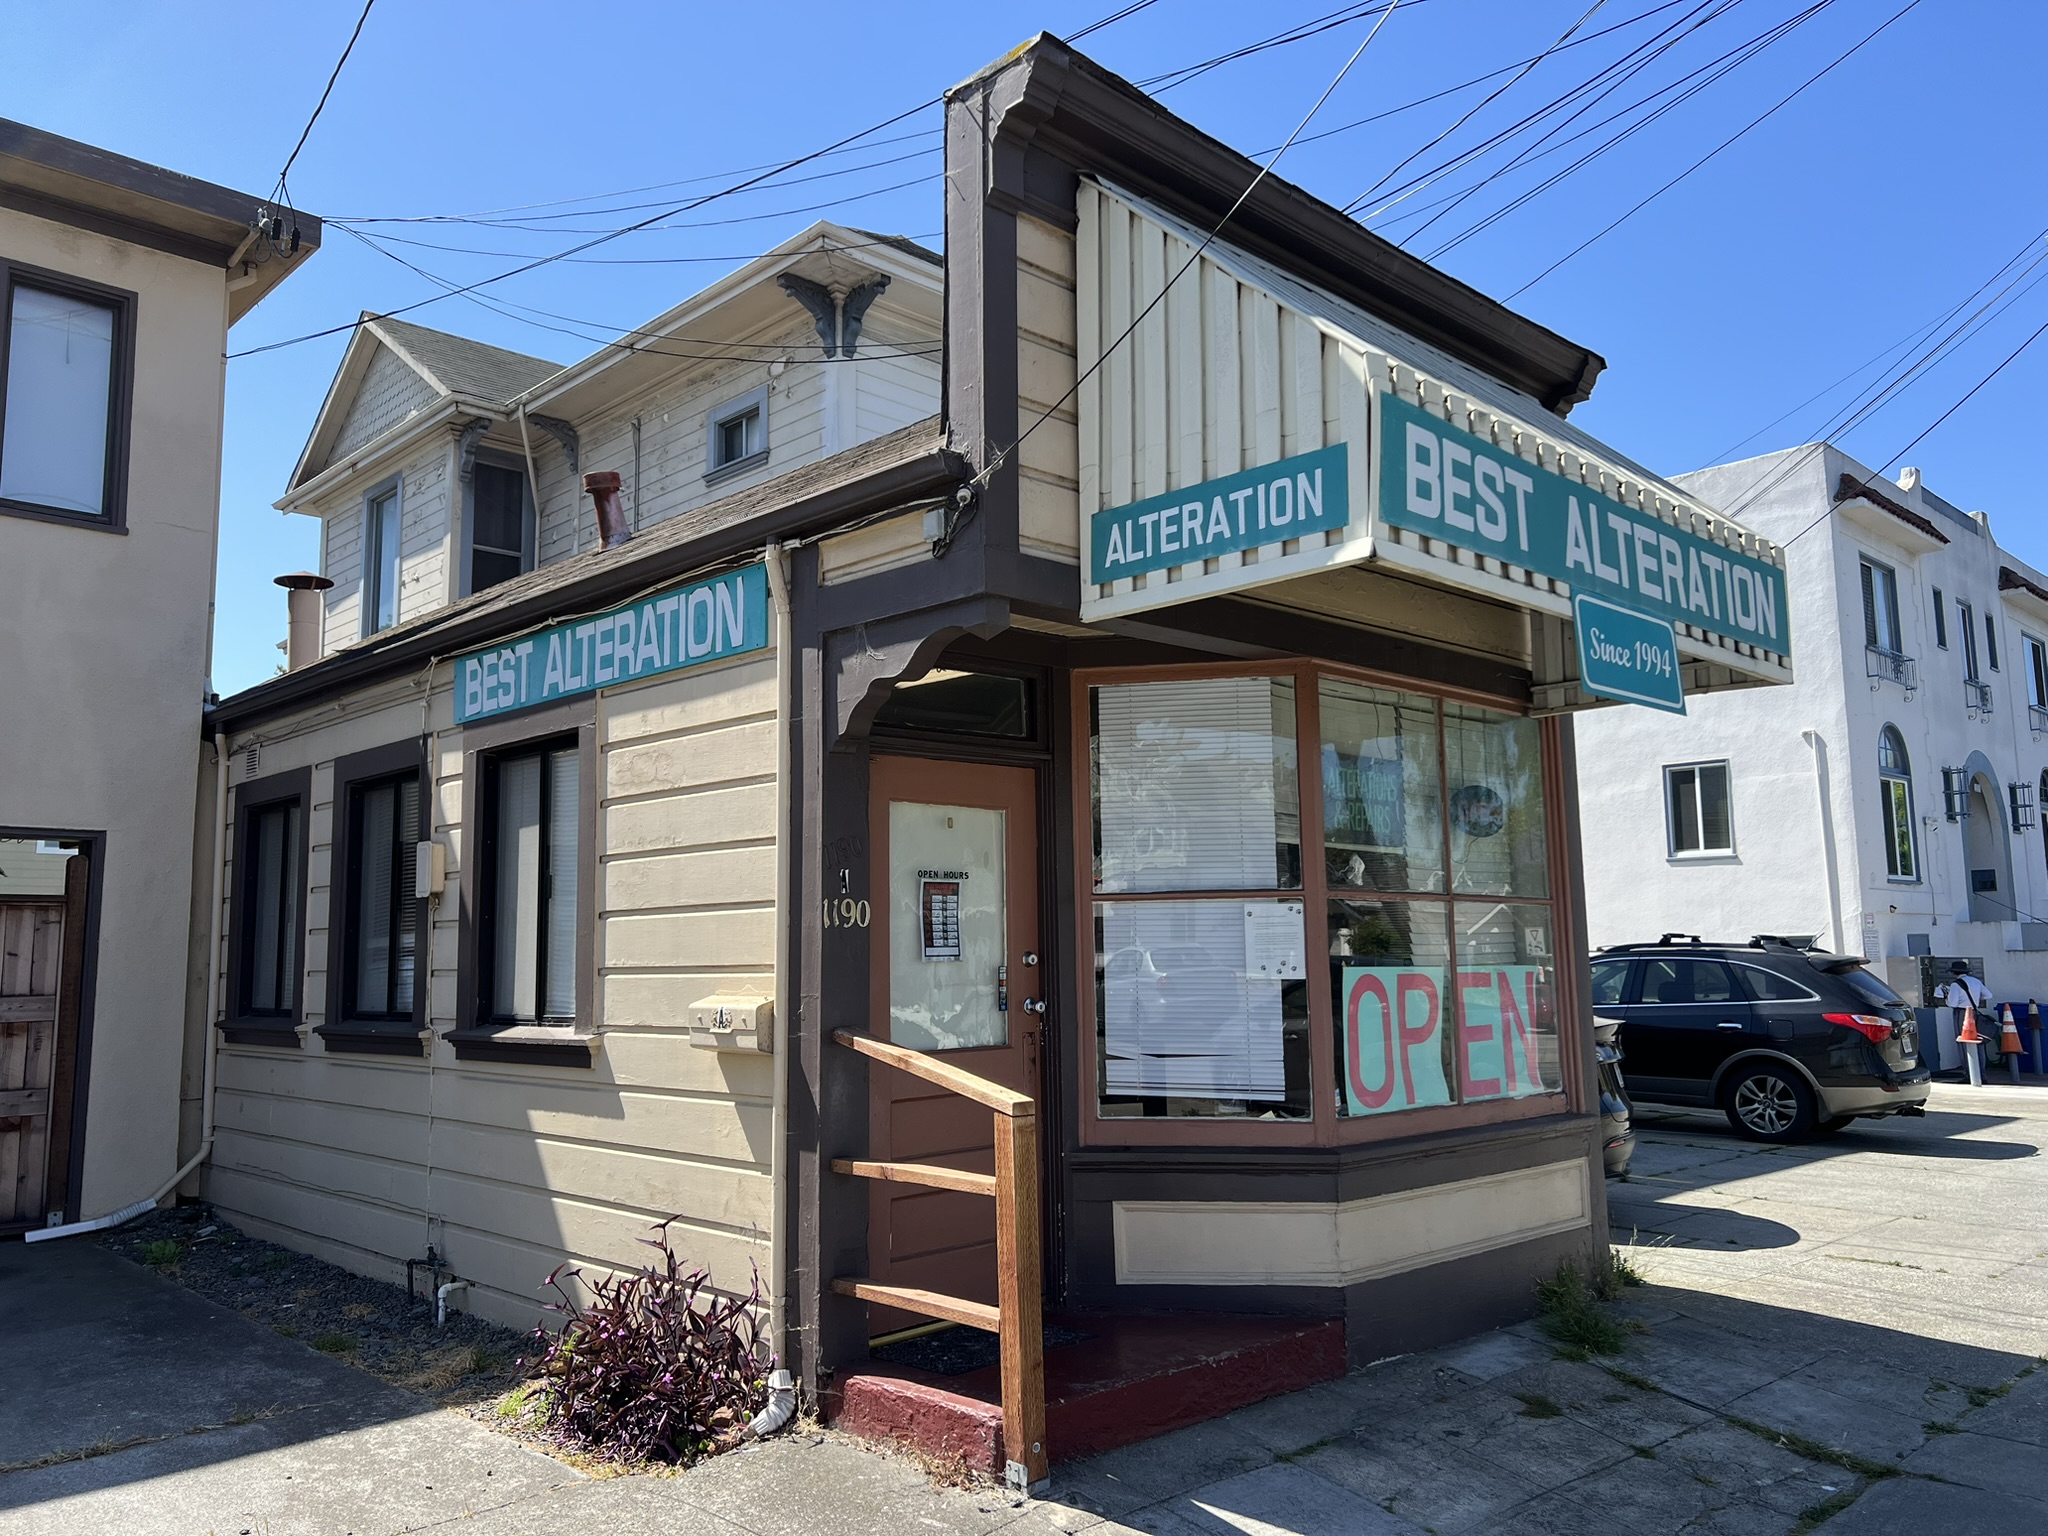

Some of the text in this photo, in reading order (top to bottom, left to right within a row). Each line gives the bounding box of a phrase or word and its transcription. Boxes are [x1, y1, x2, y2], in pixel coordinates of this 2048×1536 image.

[1104, 468, 1323, 568] ALTERATION
[1406, 422, 1777, 640] BEST ALTERATION
[465, 576, 744, 717] BEST ALTERATION
[1590, 627, 1672, 678] Since 1994
[1327, 766, 1397, 801] ALTERATIONS
[1348, 802, 1391, 833] REPAIRS
[917, 870, 969, 880] OPEN HOURS
[822, 898, 871, 929] 1190
[1347, 971, 1542, 1109] OPEN
